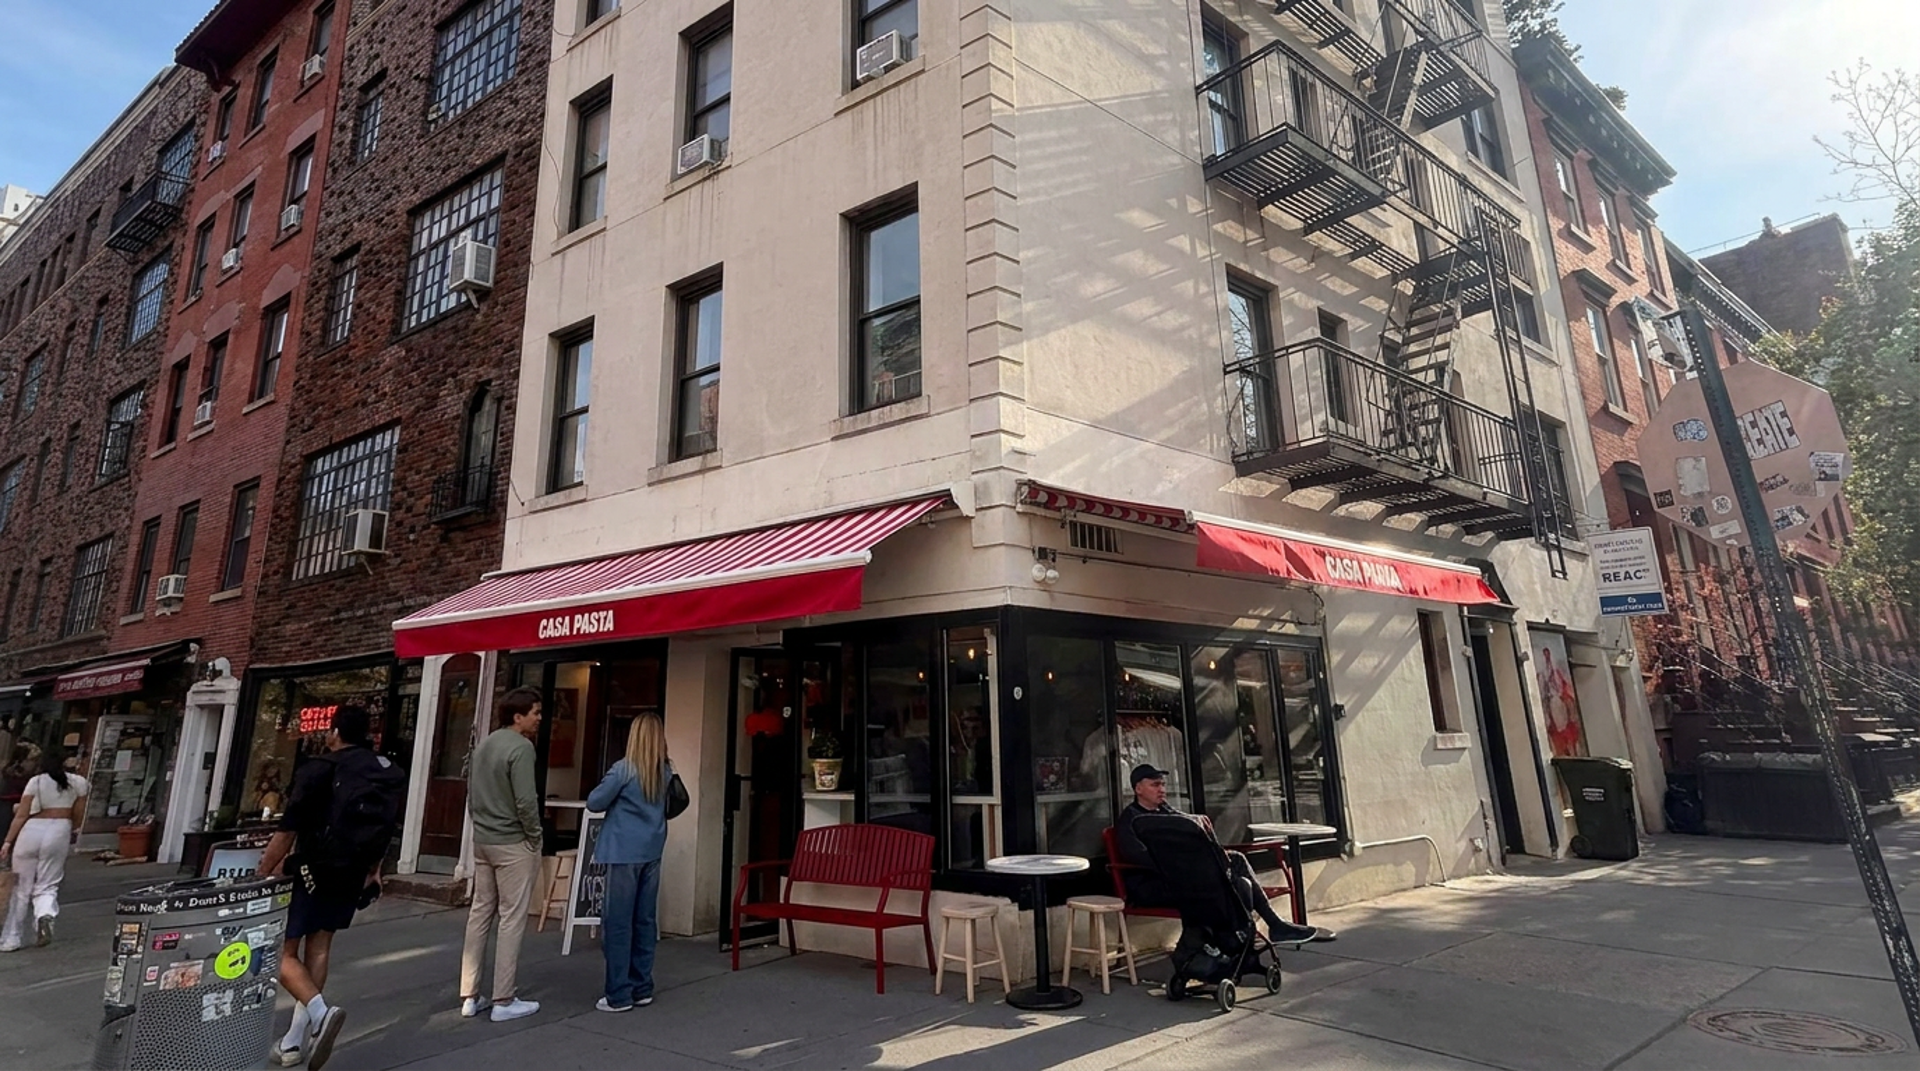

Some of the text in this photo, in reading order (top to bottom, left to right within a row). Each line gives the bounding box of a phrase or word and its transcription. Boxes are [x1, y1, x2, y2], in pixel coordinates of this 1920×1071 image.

[1325, 555, 1363, 585] CASA
[538, 610, 615, 639] CASA PASTA
